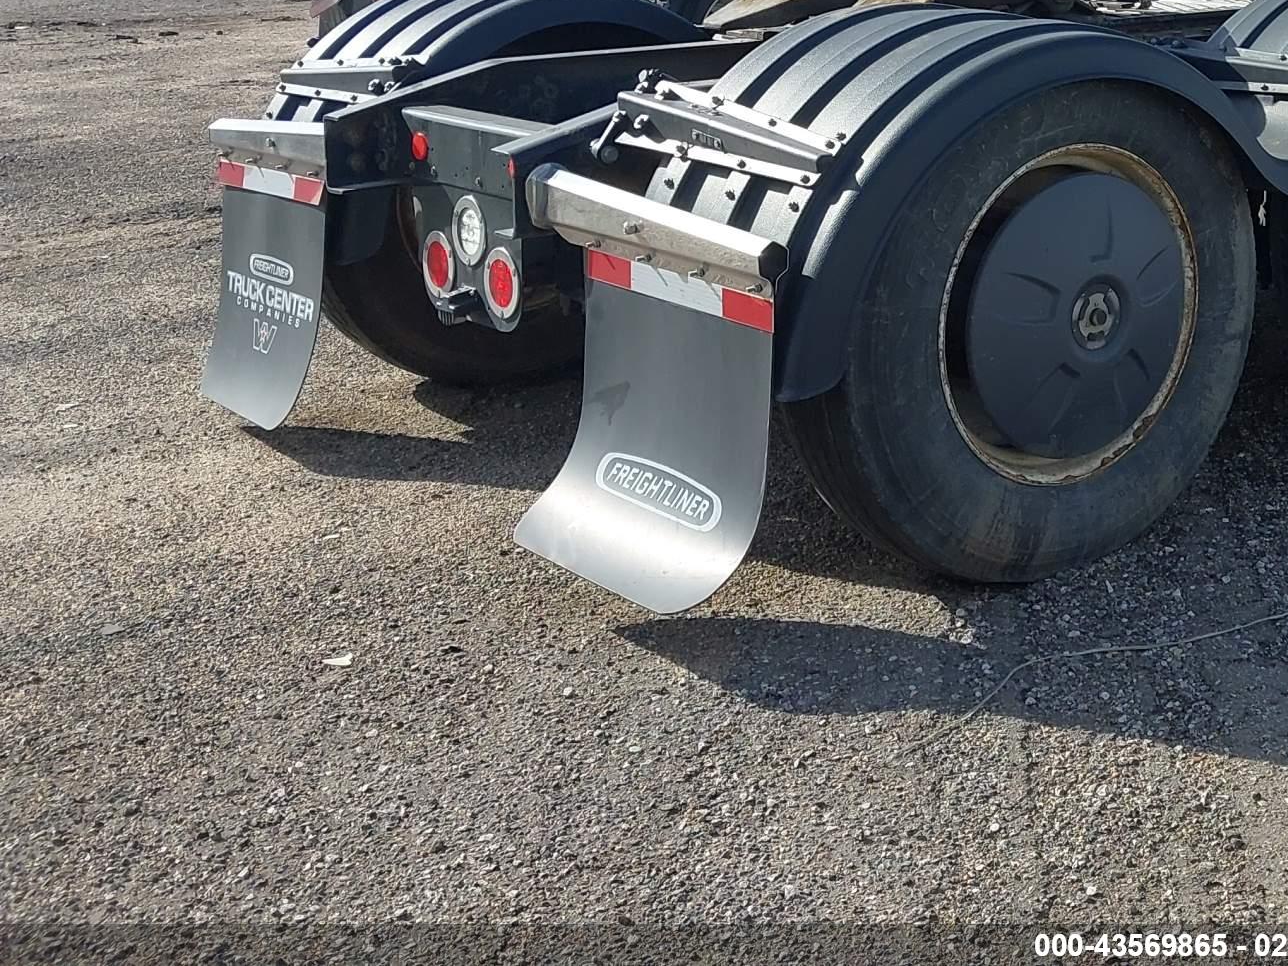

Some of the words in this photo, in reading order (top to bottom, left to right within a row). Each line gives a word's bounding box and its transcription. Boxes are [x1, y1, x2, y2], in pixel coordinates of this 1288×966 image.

[227, 270, 266, 305] TRUCK
[265, 284, 315, 323] CENTER
[236, 295, 301, 329] COMPANIES
[606, 461, 711, 521] FREIGHTLINER
